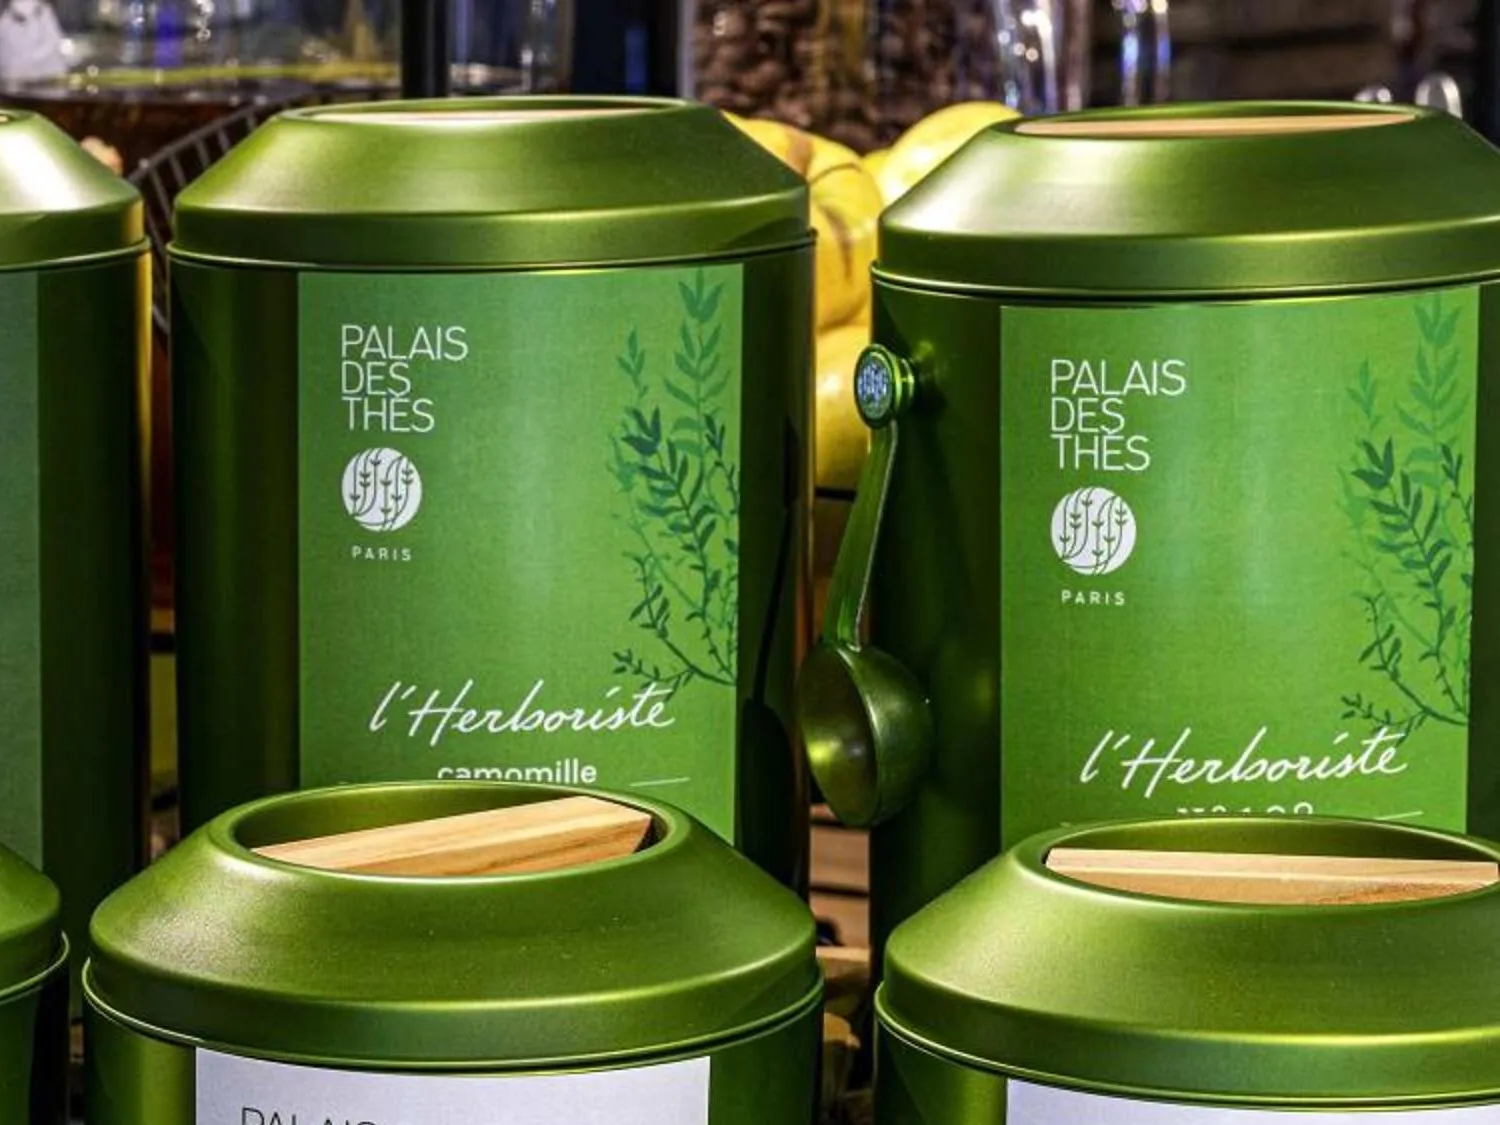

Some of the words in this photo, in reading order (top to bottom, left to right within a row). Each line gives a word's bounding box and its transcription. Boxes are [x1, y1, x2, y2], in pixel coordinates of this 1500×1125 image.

[340, 324, 469, 363] PALAIS
[341, 361, 411, 397] DES
[1050, 358, 1187, 397] PALAIS
[1050, 396, 1126, 434] DES
[352, 545, 412, 563] PARIS
[1061, 588, 1126, 607] PARIS
